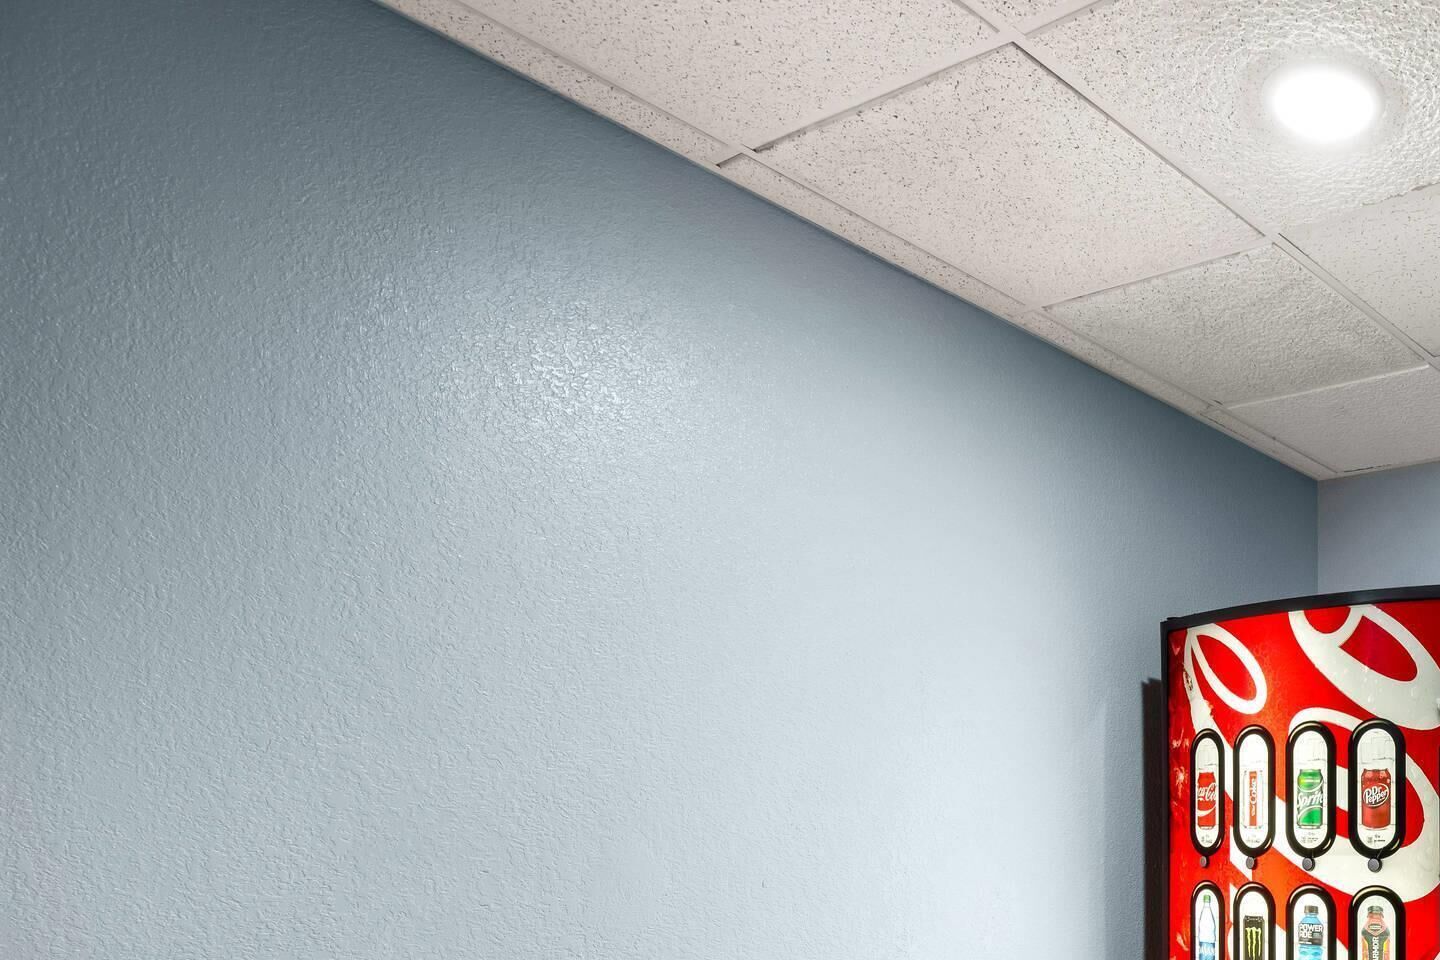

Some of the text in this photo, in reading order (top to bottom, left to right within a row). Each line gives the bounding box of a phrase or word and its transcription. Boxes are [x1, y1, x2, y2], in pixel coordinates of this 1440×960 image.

[1249, 777, 1257, 804] Coke
[1365, 787, 1387, 805] Pepper
[1372, 785, 1383, 796] Dr
[1300, 923, 1323, 932] POWER
